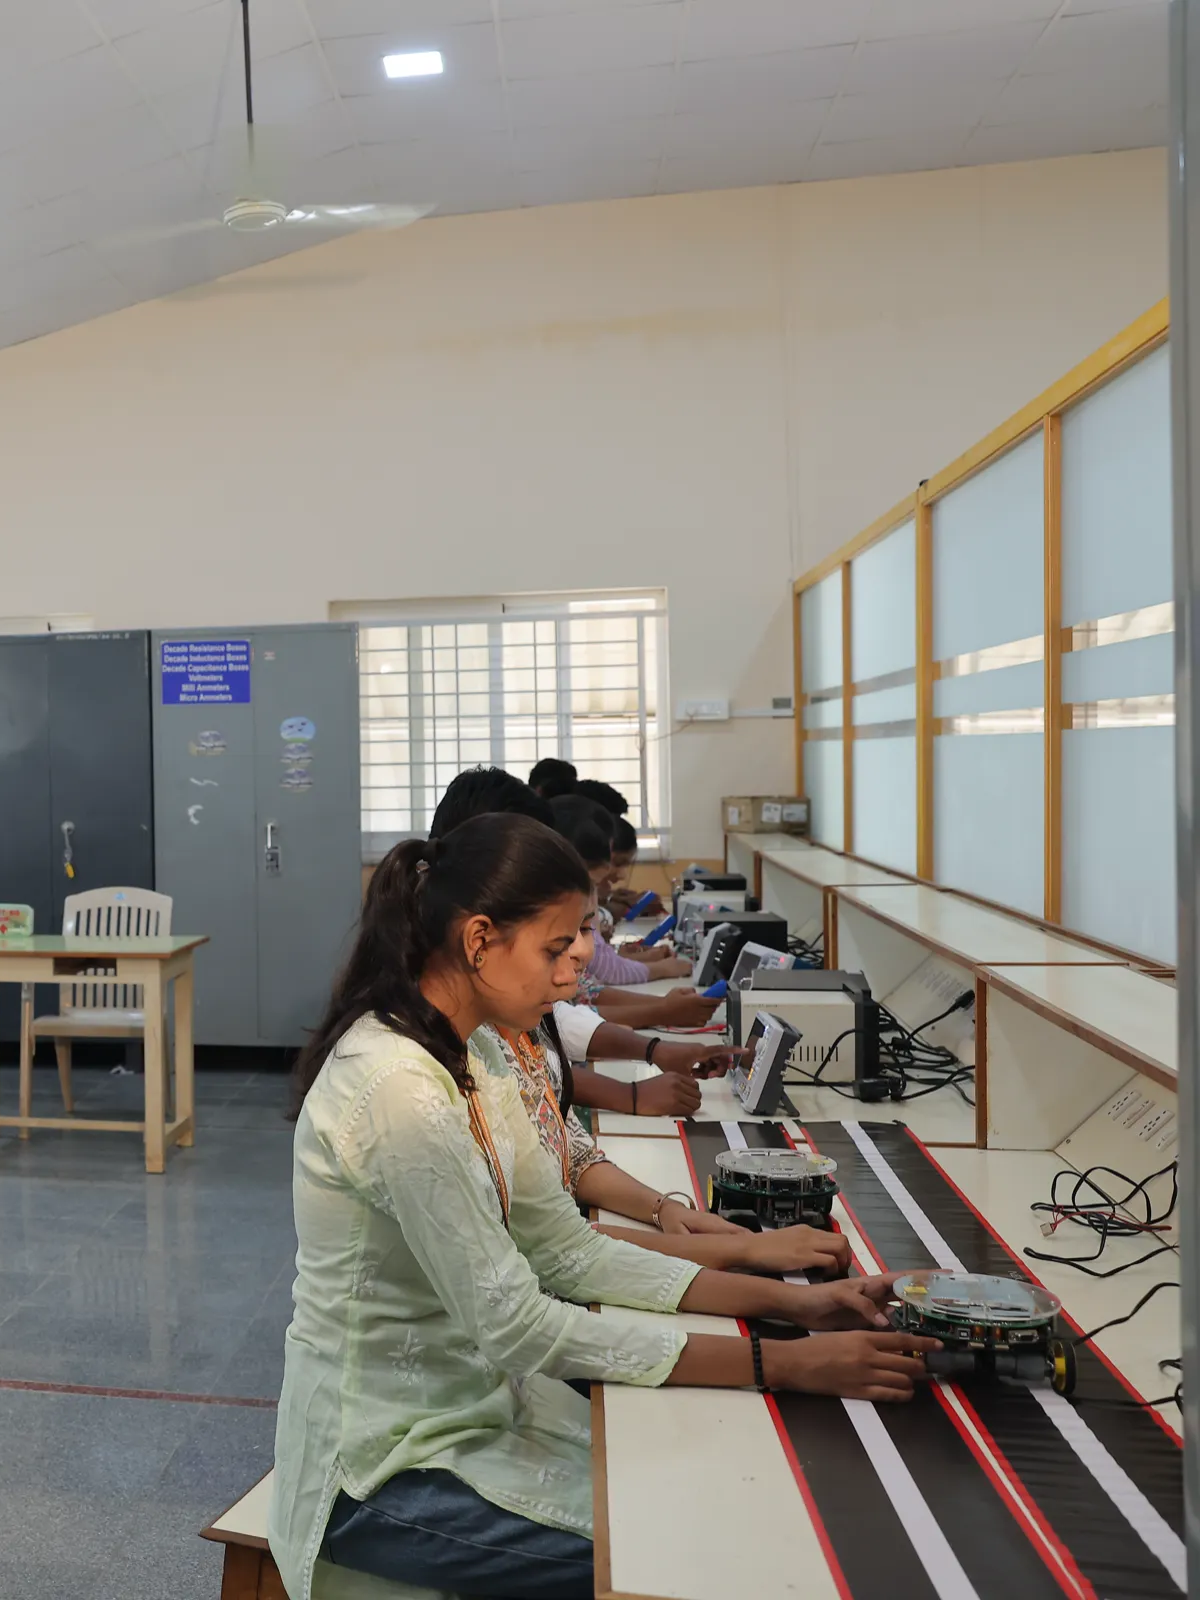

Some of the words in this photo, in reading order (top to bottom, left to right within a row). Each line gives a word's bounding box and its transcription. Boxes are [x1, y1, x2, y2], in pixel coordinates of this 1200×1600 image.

[163, 645, 188, 653] Decade
[189, 644, 225, 652] Resistance
[226, 643, 247, 652] Boxes
[163, 655, 188, 663] Decade
[189, 654, 225, 662] Inductance
[226, 653, 247, 662] Boxes
[162, 664, 186, 672] Decade
[187, 664, 227, 673] Capacitance
[228, 663, 249, 671] Boxes
[188, 674, 223, 682] Voltmeters
